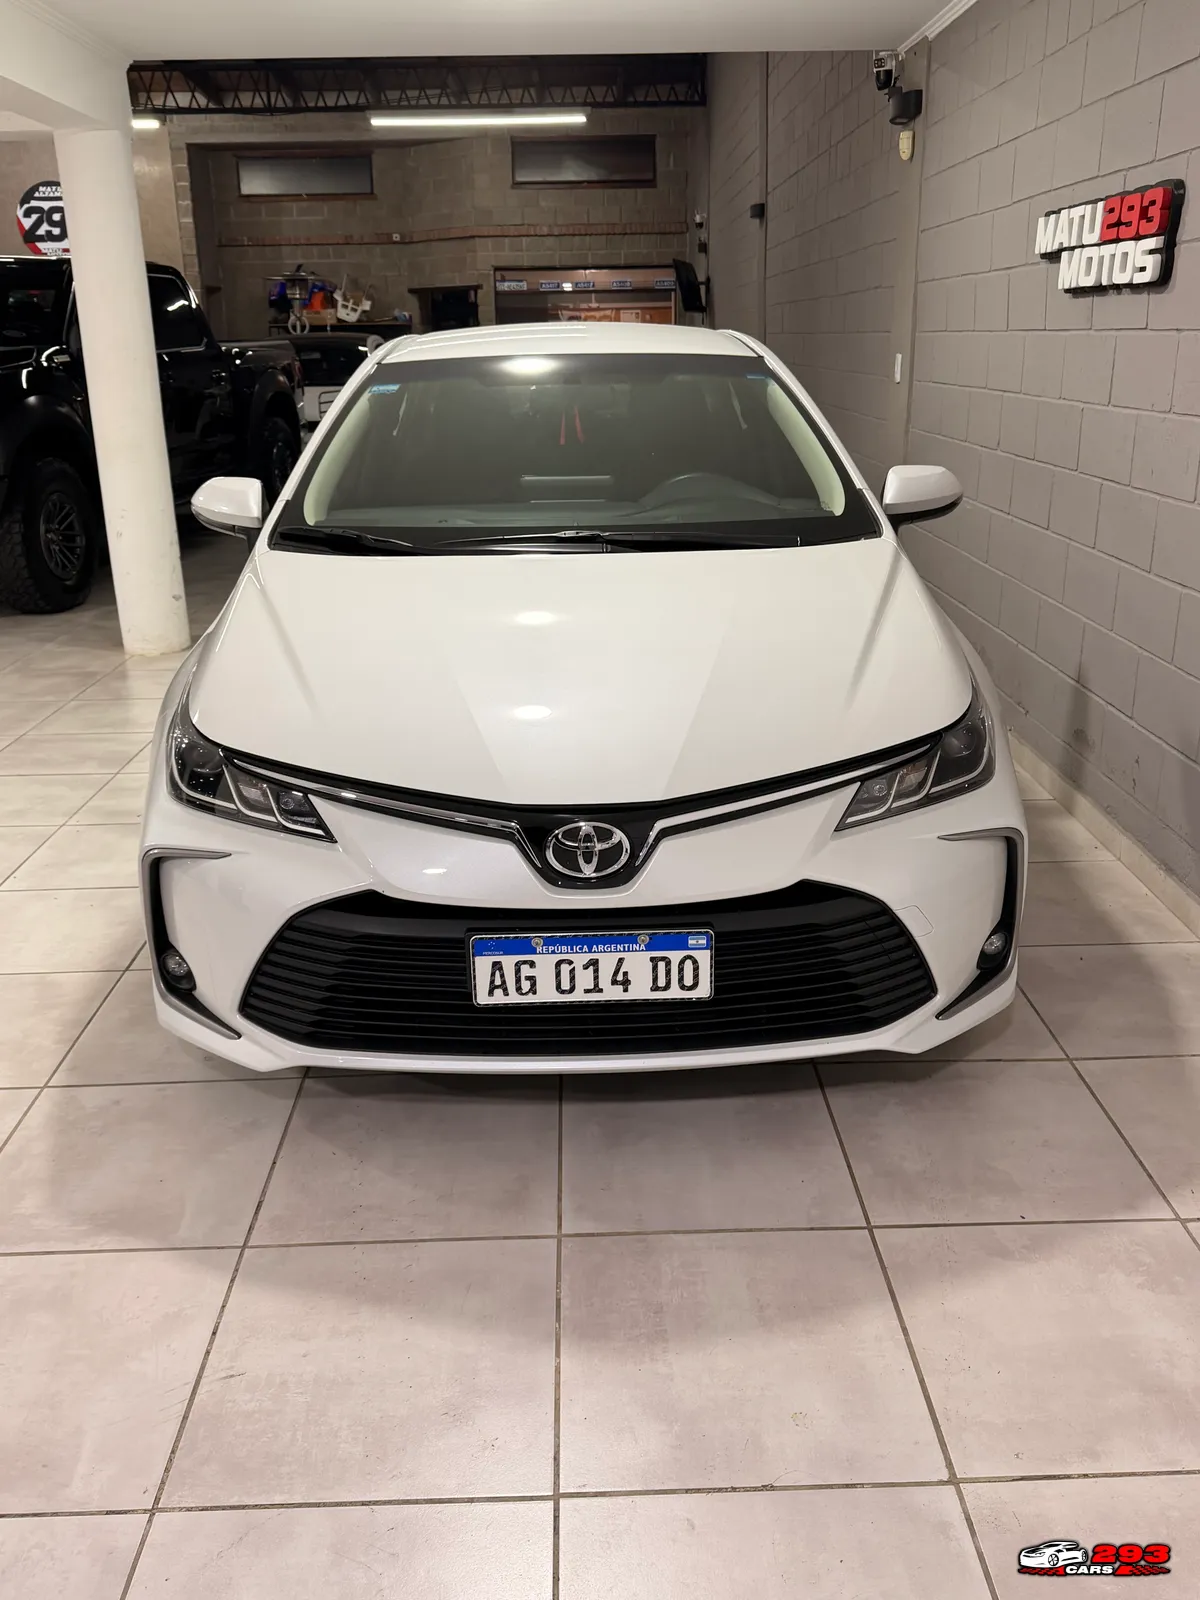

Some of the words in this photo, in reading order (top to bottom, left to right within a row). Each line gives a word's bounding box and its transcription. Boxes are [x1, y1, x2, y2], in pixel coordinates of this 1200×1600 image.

[1058, 236, 1164, 290] MOTOS
[536, 943, 589, 954] REPÚBLICA
[592, 943, 646, 953] ARGENTINA
[487, 959, 538, 997] AG
[554, 957, 632, 995] 014
